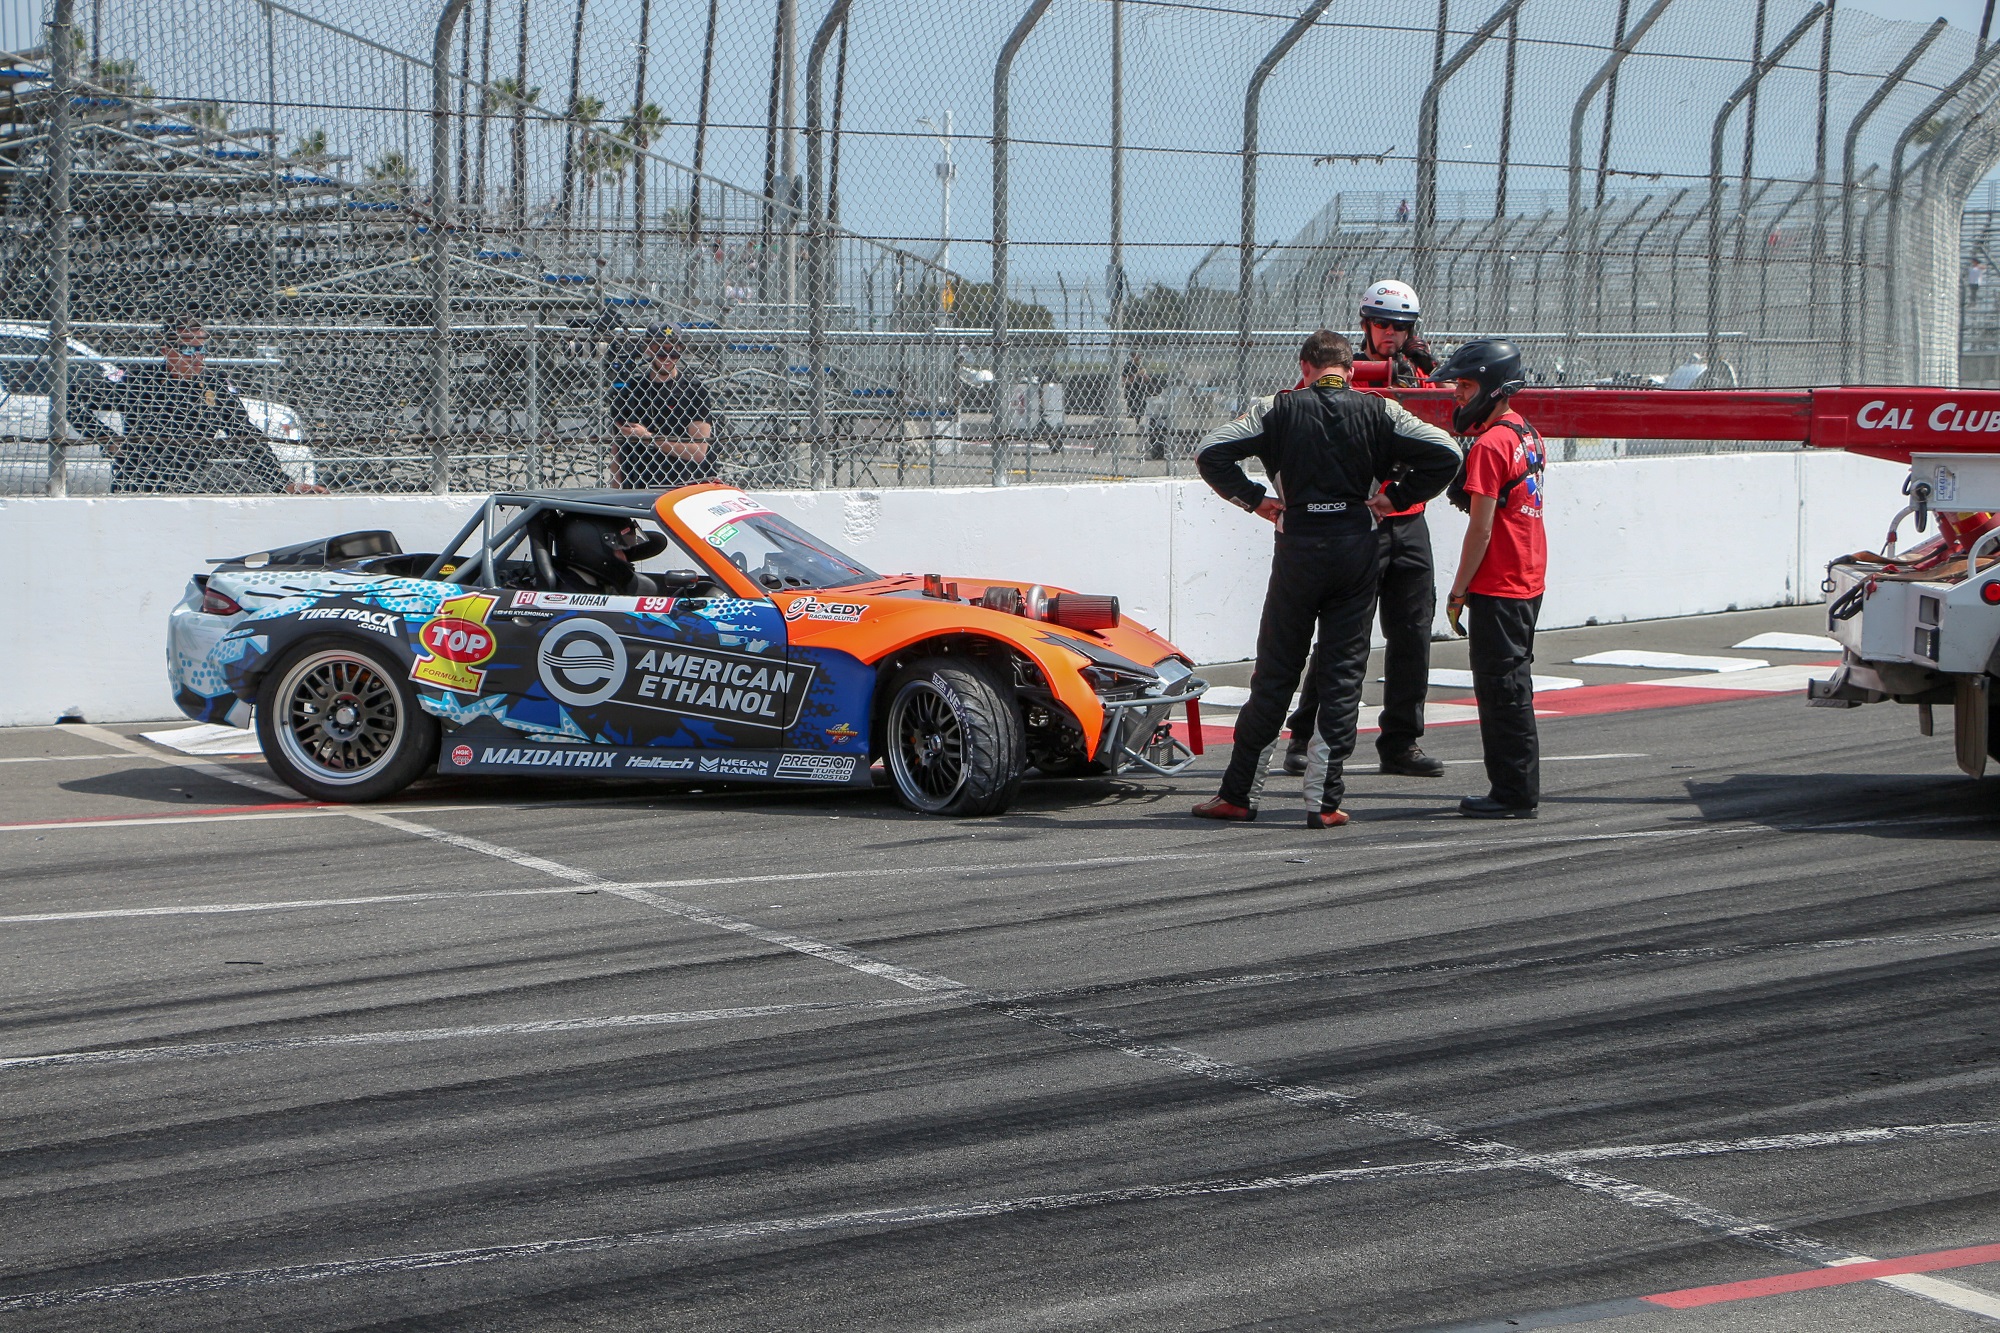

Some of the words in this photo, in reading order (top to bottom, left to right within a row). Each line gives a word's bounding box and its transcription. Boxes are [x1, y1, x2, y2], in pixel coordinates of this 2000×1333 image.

[1307, 501, 1347, 512] sparco
[519, 592, 535, 604] FD
[568, 594, 610, 607] MOHAN
[643, 596, 666, 611] 99
[805, 603, 868, 616] EXEDY
[357, 622, 389, 634] .com
[431, 625, 488, 654] TOP
[422, 667, 473, 684] FORMULA-1
[634, 649, 795, 694] AMERICAN
[637, 674, 777, 718] ETHANOL
[480, 747, 618, 768] MAZDATRIX
[624, 755, 694, 769] Haltech
[720, 758, 769, 768] MEGAN
[719, 765, 767, 776] RACING
[811, 773, 850, 781] BOOSTED
